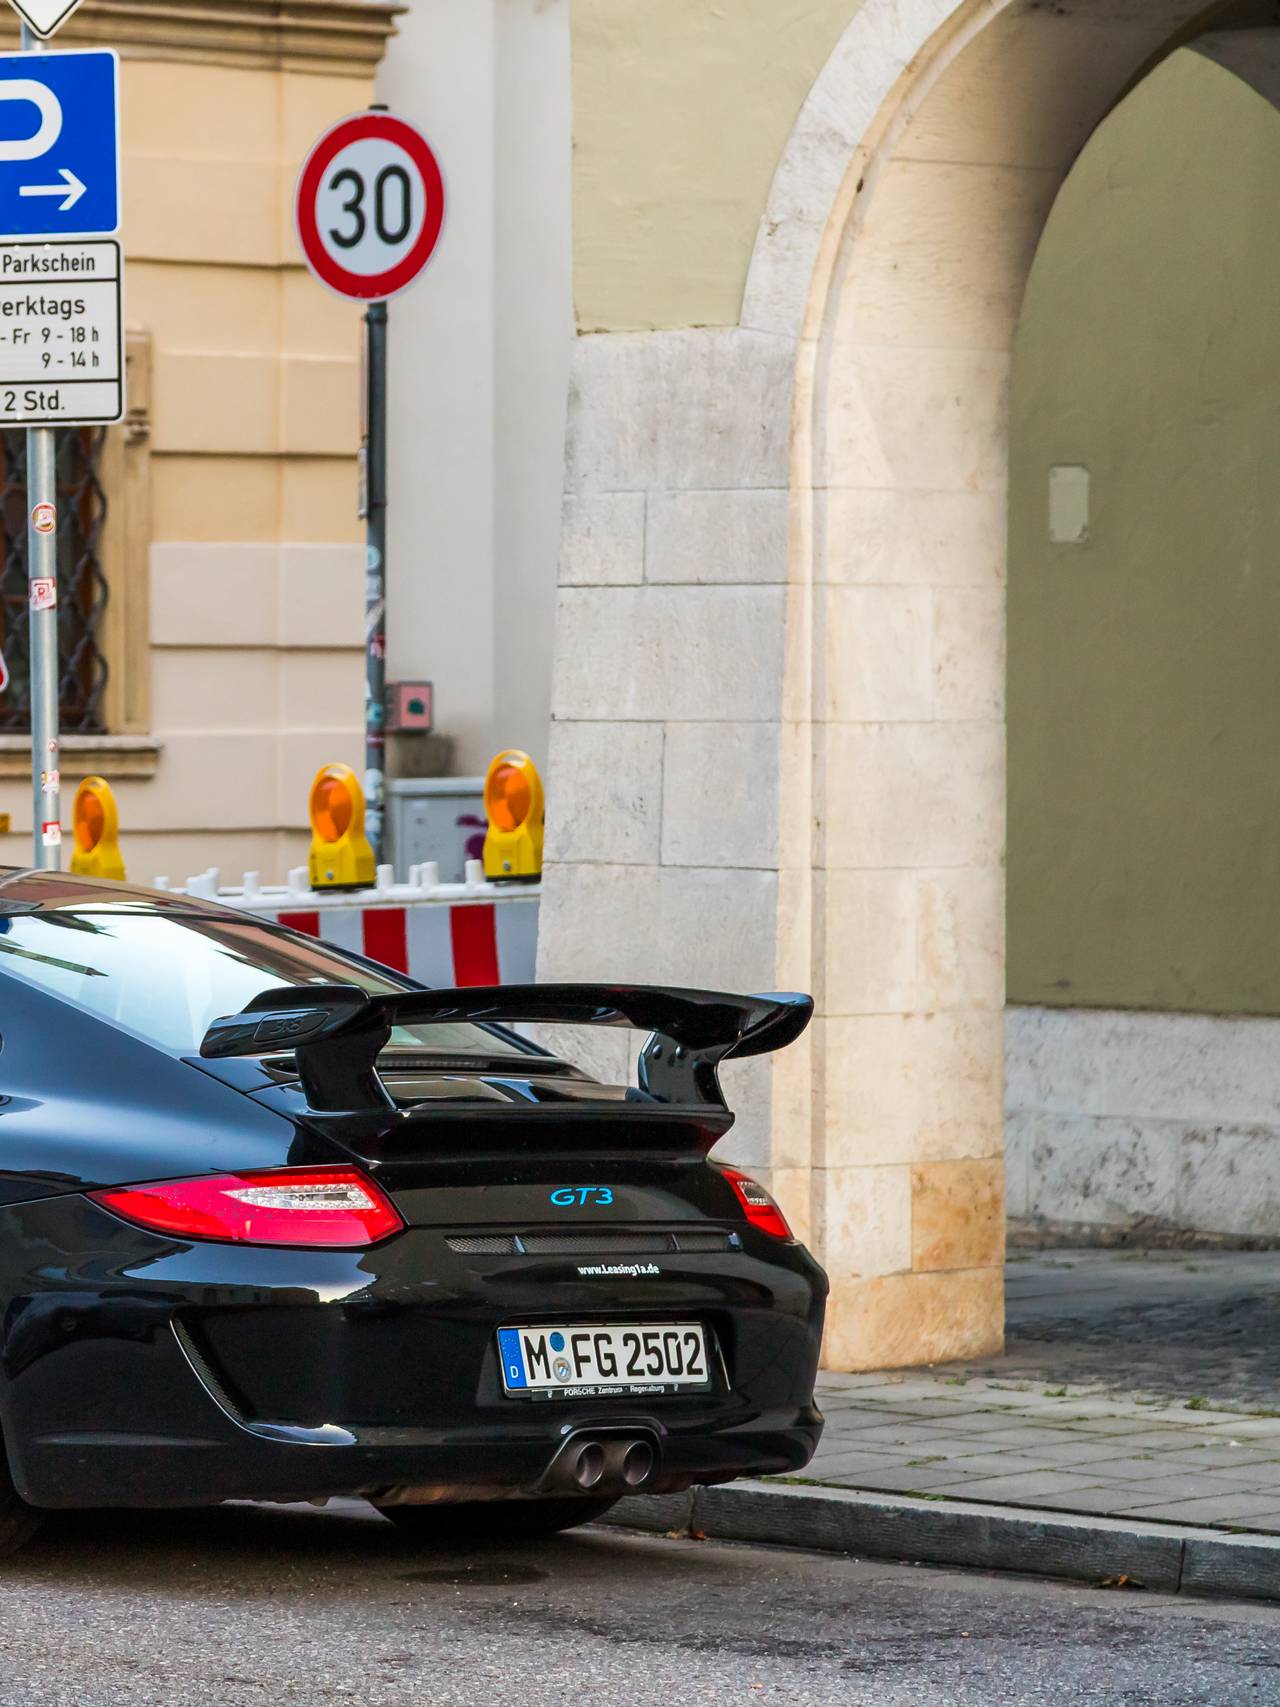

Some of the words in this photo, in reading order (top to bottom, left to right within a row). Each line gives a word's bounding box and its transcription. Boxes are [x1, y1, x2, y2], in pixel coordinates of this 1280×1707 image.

[329, 163, 412, 249] 30
[3, 252, 96, 273] Parkschein
[13, 328, 31, 344] Fr
[41, 327, 51, 344] 9
[70, 326, 86, 343] 18
[92, 326, 100, 342] h
[41, 352, 51, 368] 9
[70, 351, 86, 367] 14
[92, 351, 100, 367] h
[4, 391, 17, 412] 2
[24, 390, 66, 411] Std.
[549, 1187, 614, 1206] GT3
[577, 1263, 660, 1276] www.Leasing1a.de
[523, 1334, 552, 1380] M
[509, 1365, 519, 1379] D
[563, 1387, 596, 1396] PORSCHE
